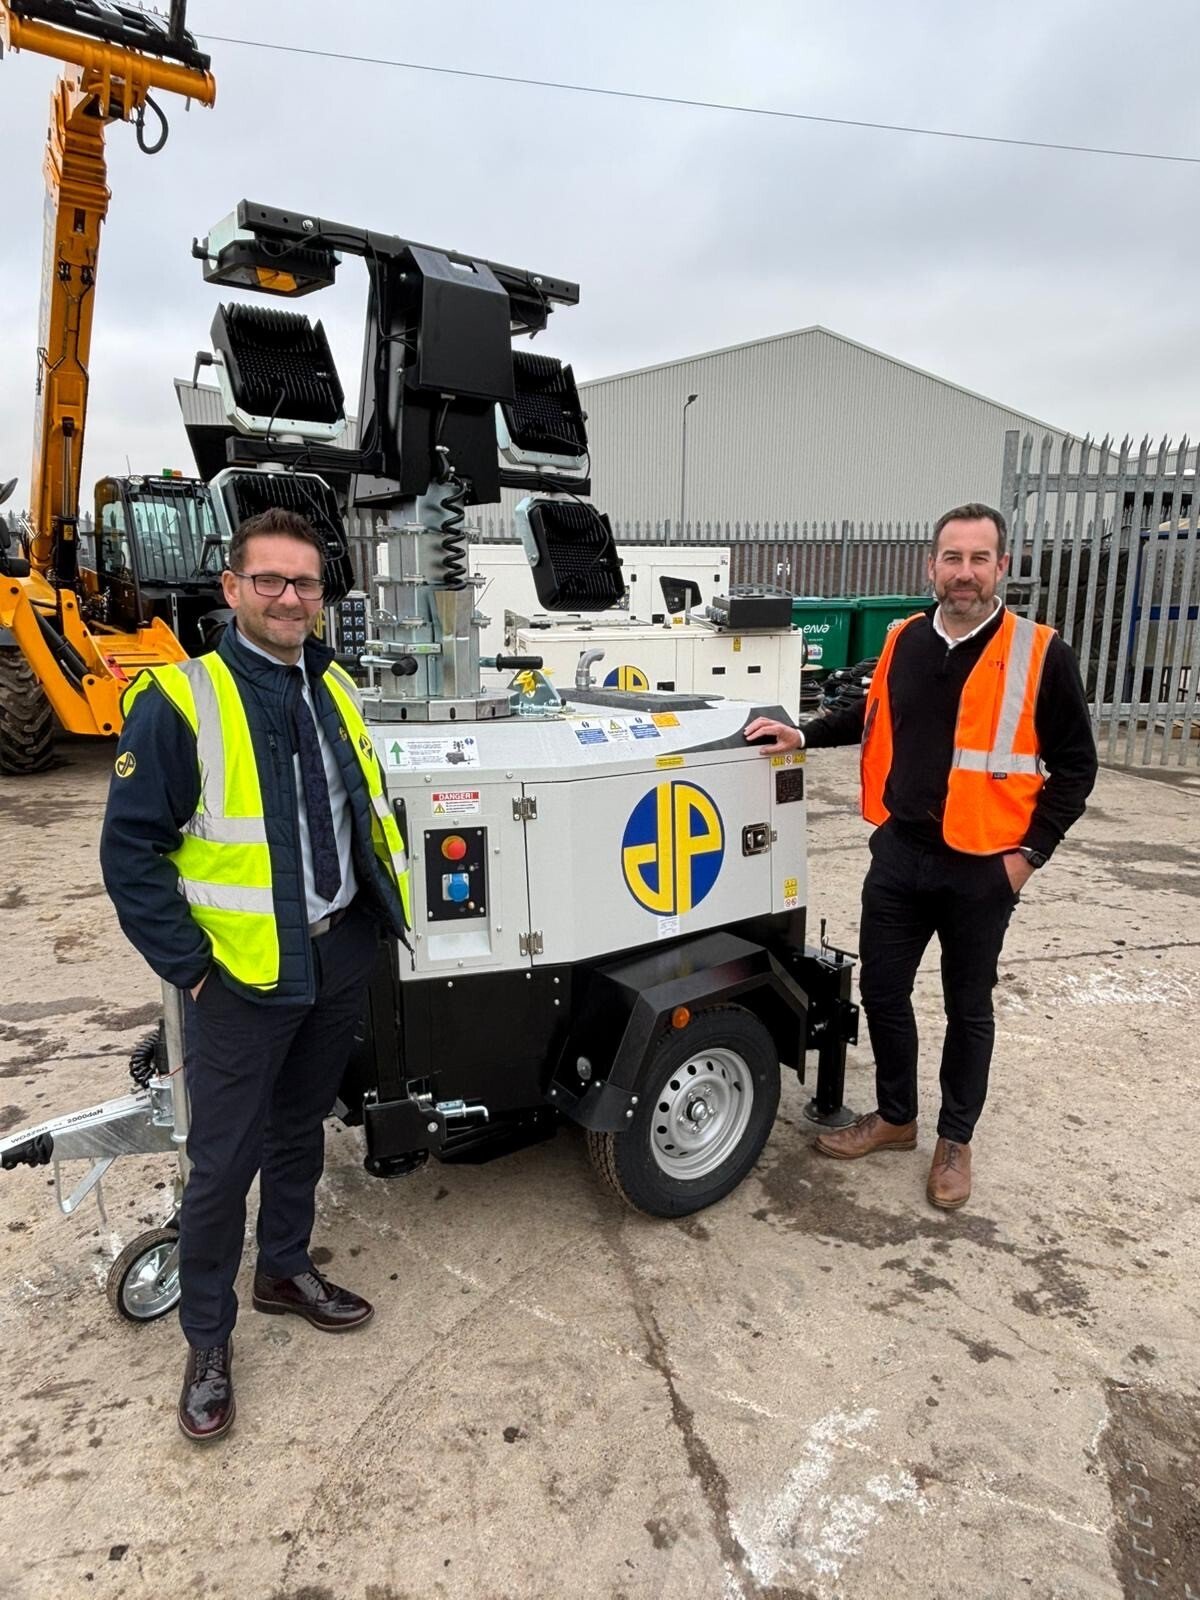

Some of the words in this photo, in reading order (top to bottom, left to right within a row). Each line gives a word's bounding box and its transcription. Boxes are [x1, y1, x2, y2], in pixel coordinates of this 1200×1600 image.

[803, 624, 830, 634] enva
[439, 792, 473, 800] DANGER!
[622, 780, 725, 916] JP
[67, 1108, 103, 1123] 2000daN
